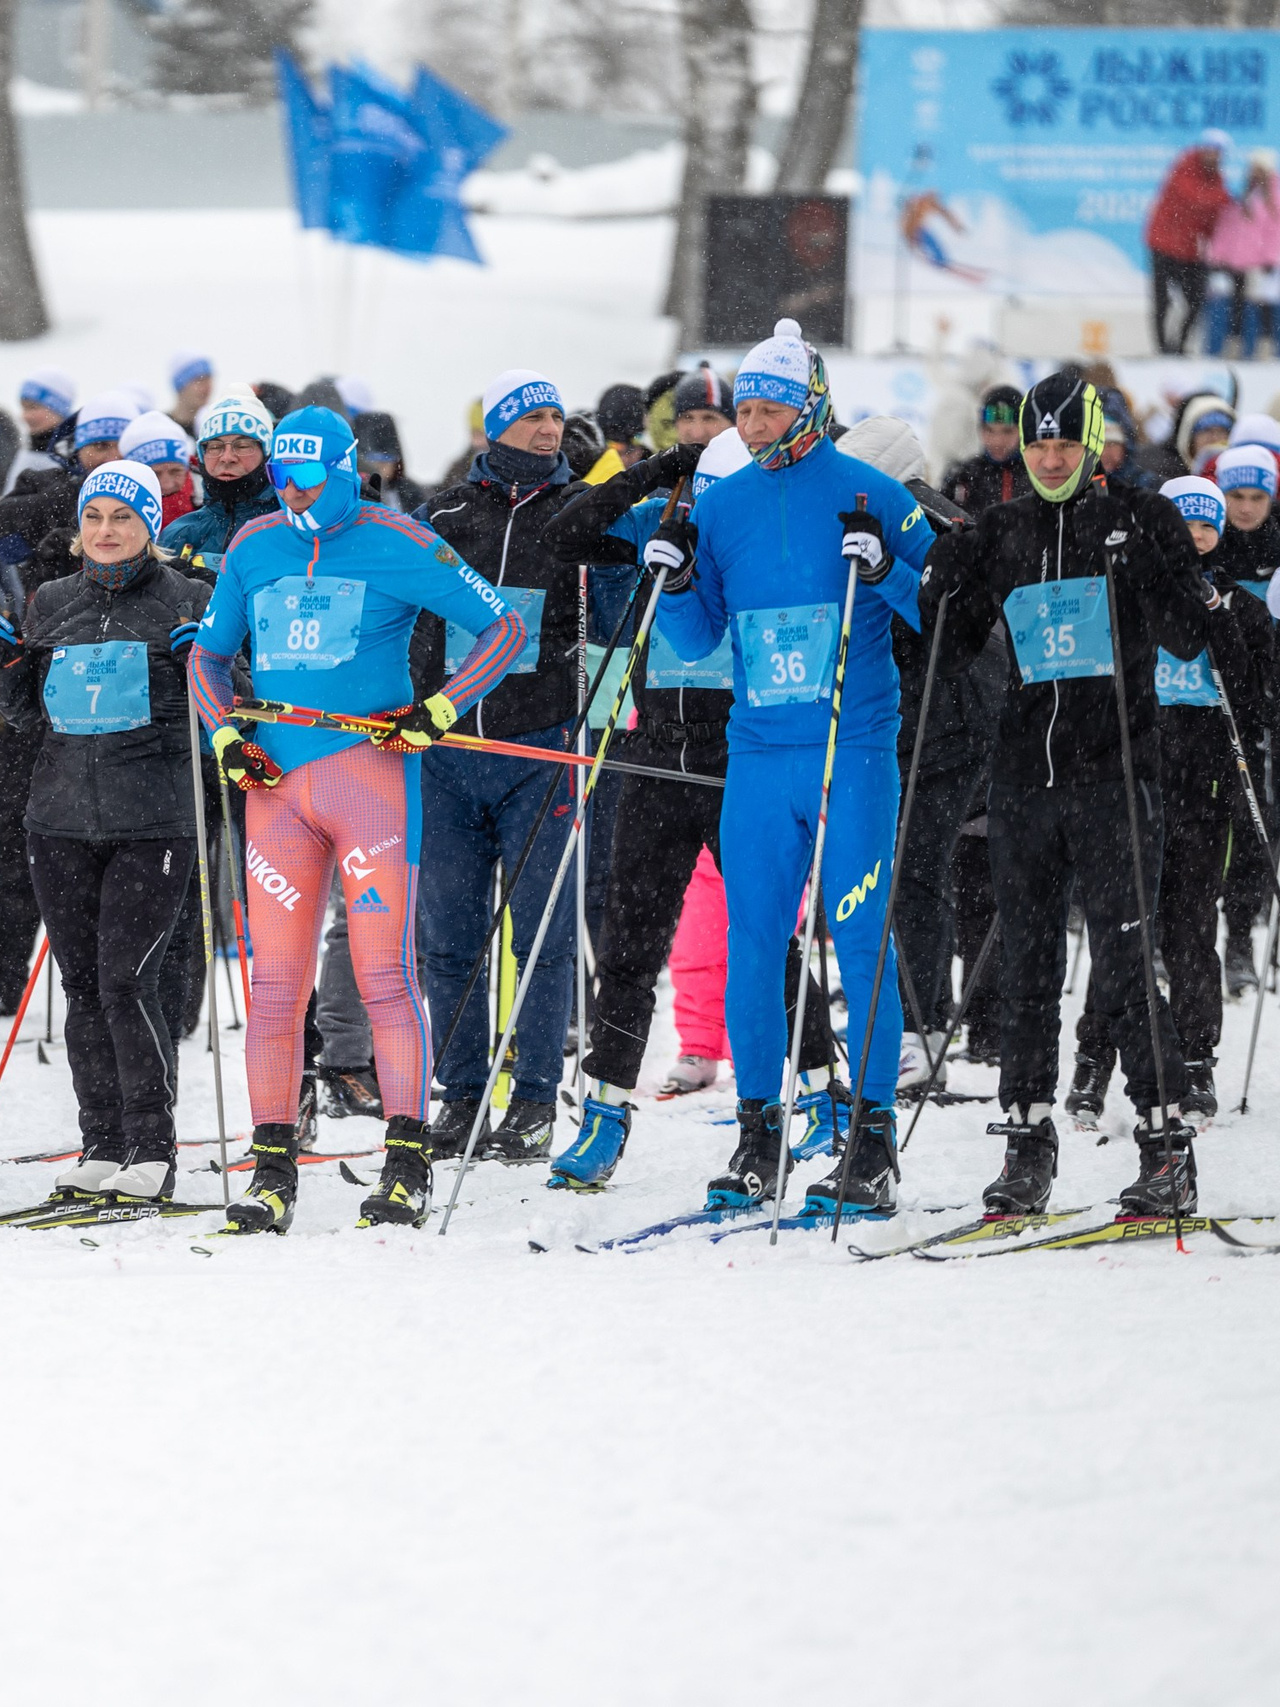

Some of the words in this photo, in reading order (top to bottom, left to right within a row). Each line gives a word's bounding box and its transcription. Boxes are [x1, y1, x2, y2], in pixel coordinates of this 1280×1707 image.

[277, 438, 317, 455] DKB
[458, 565, 506, 617] LUKOIL
[287, 619, 320, 650] 88
[1042, 624, 1076, 658] 35
[86, 667, 117, 675] РОССИИ
[770, 651, 806, 685] 36
[1155, 663, 1202, 690] 843
[85, 685, 102, 715] 7
[368, 834, 402, 857] RUSAL
[836, 859, 882, 922] OW
[350, 904, 390, 913] adidas
[385, 1139, 423, 1149] FISCHER
[98, 1207, 160, 1221] FISCHER
[815, 1214, 865, 1229] SALMON
[993, 1215, 1049, 1236] FISCHER
[1123, 1219, 1208, 1237] FISCHER
